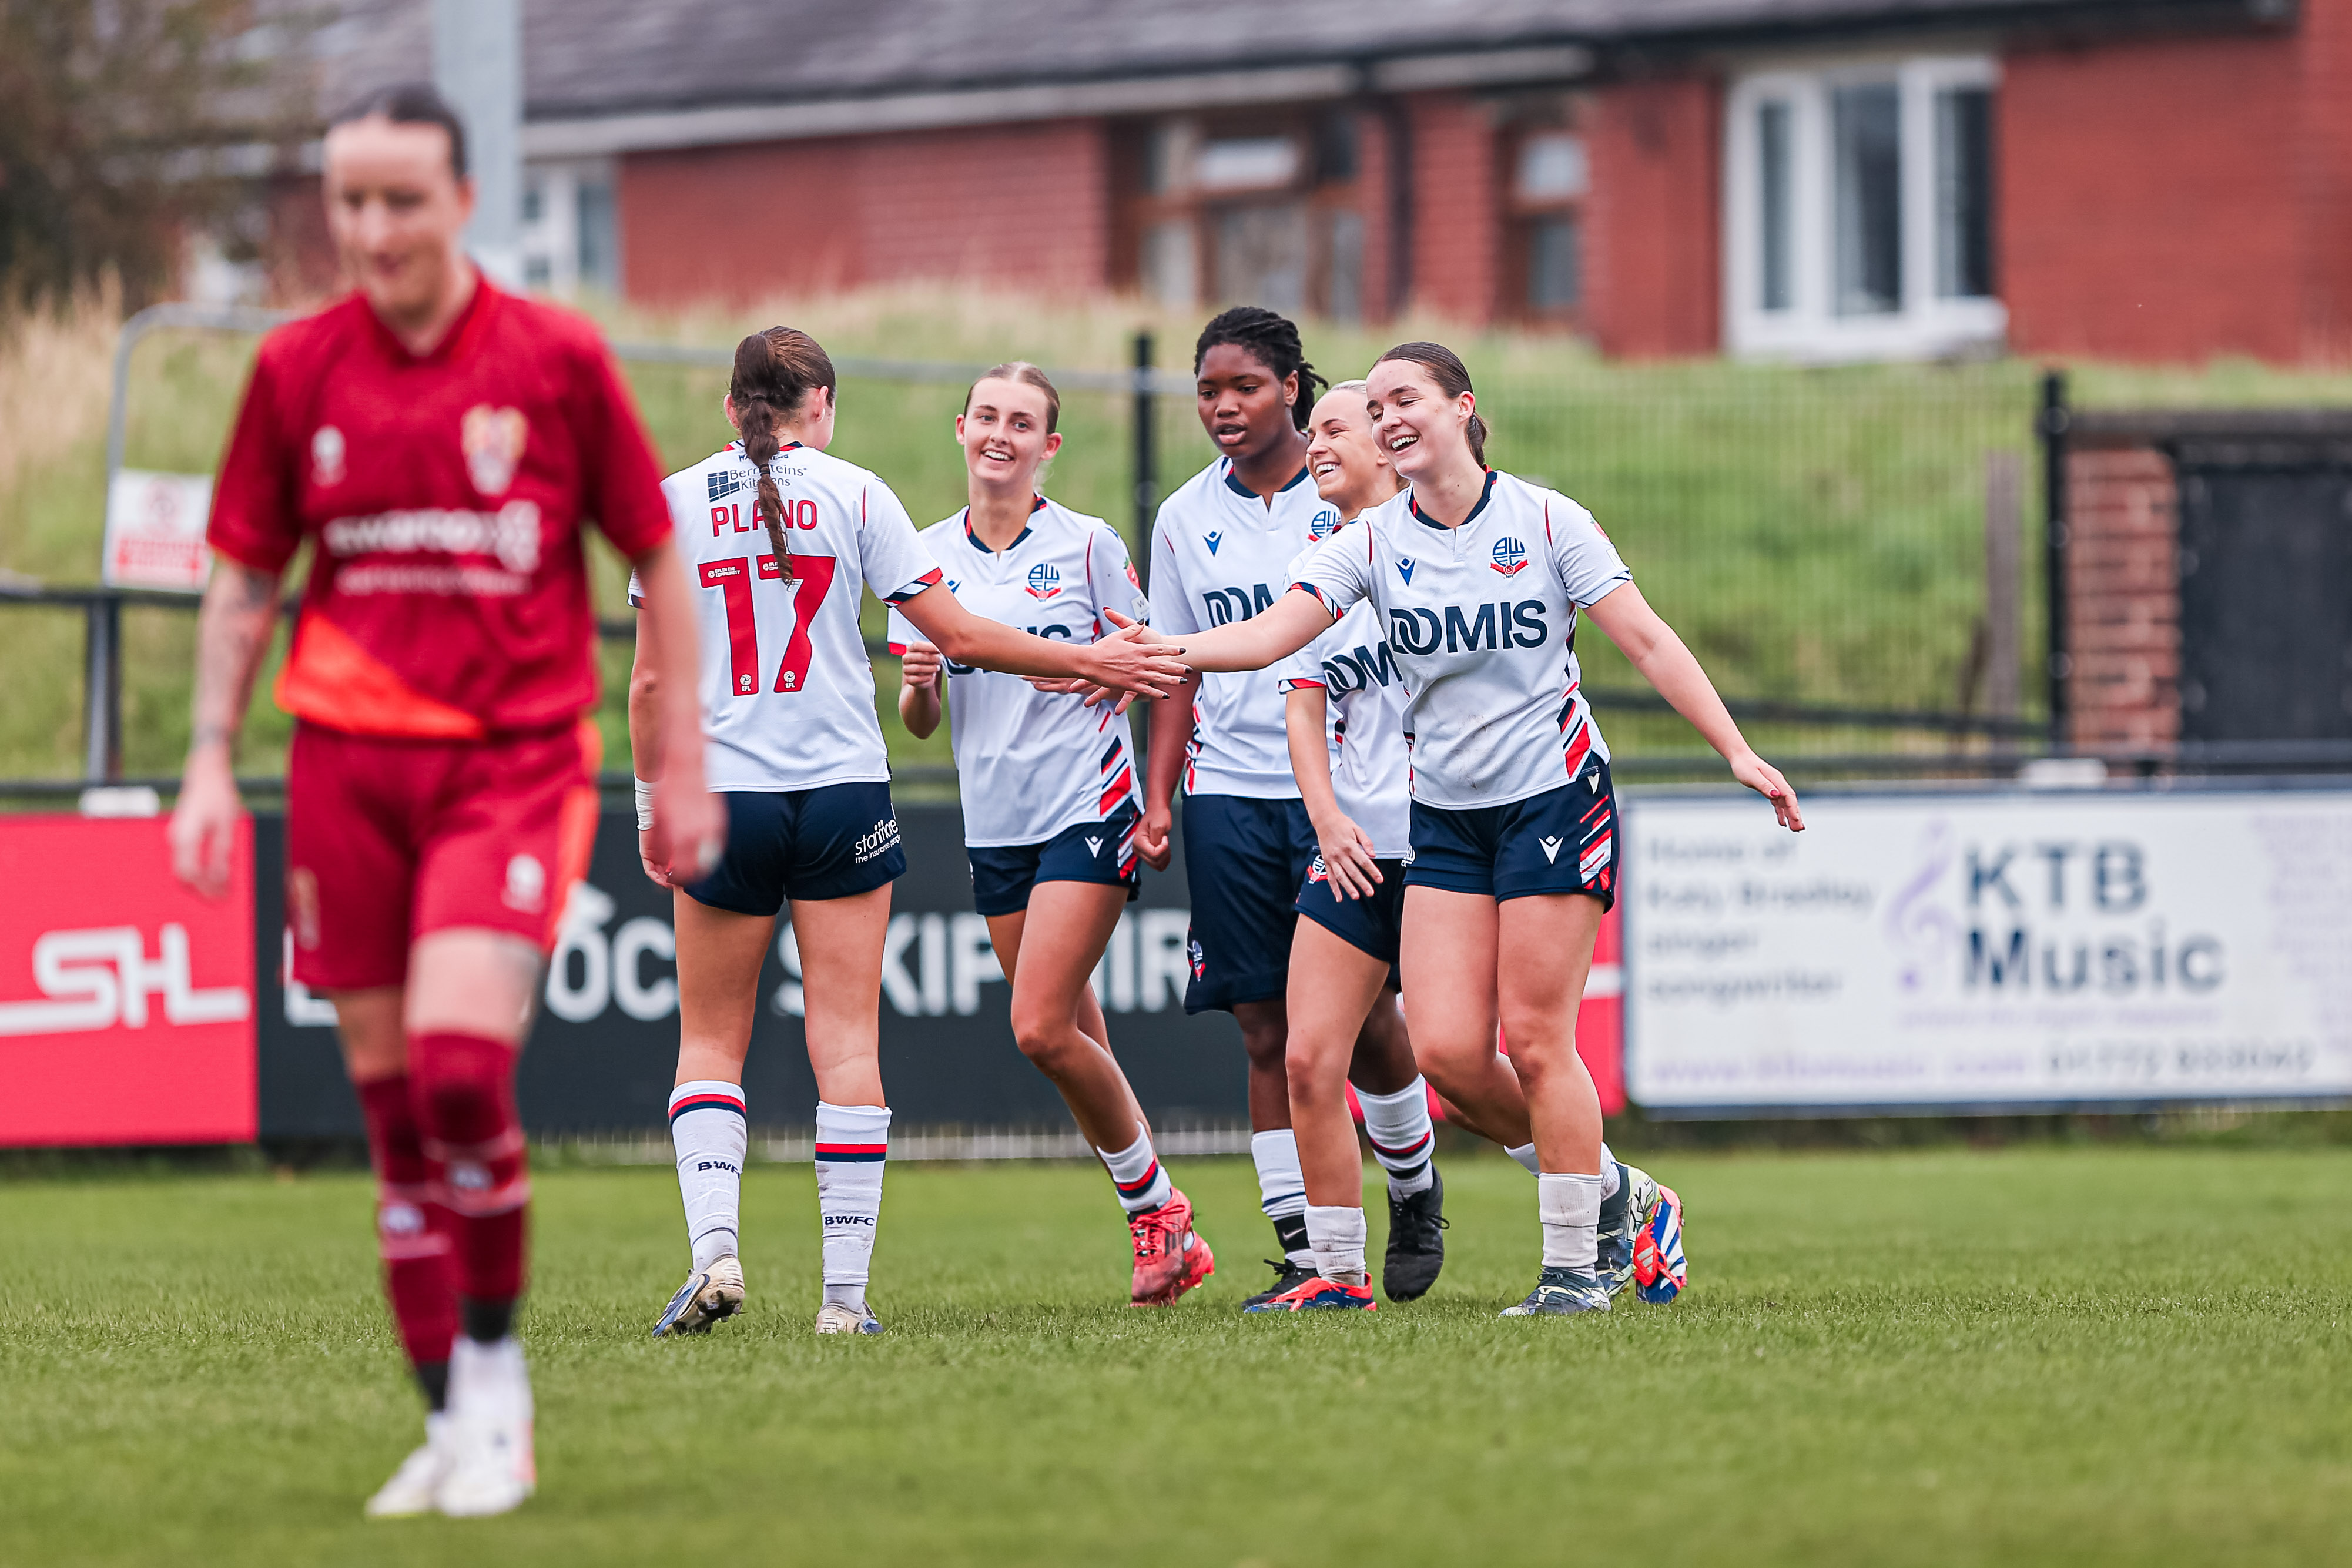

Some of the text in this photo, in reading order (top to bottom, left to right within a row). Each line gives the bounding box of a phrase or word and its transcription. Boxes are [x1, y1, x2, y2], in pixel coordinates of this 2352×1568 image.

[730, 464, 803, 480] Bernteins
[741, 477, 790, 490] Kitens
[711, 499, 817, 537] PLANO
[698, 554, 836, 696] 17
[1389, 599, 1548, 656] DOMIS
[1321, 641, 1403, 703] DOM
[1965, 841, 2149, 913] KTB
[1964, 917, 2226, 994] Music
[698, 1160, 740, 1179] BWF
[825, 1215, 875, 1226] BWFC
